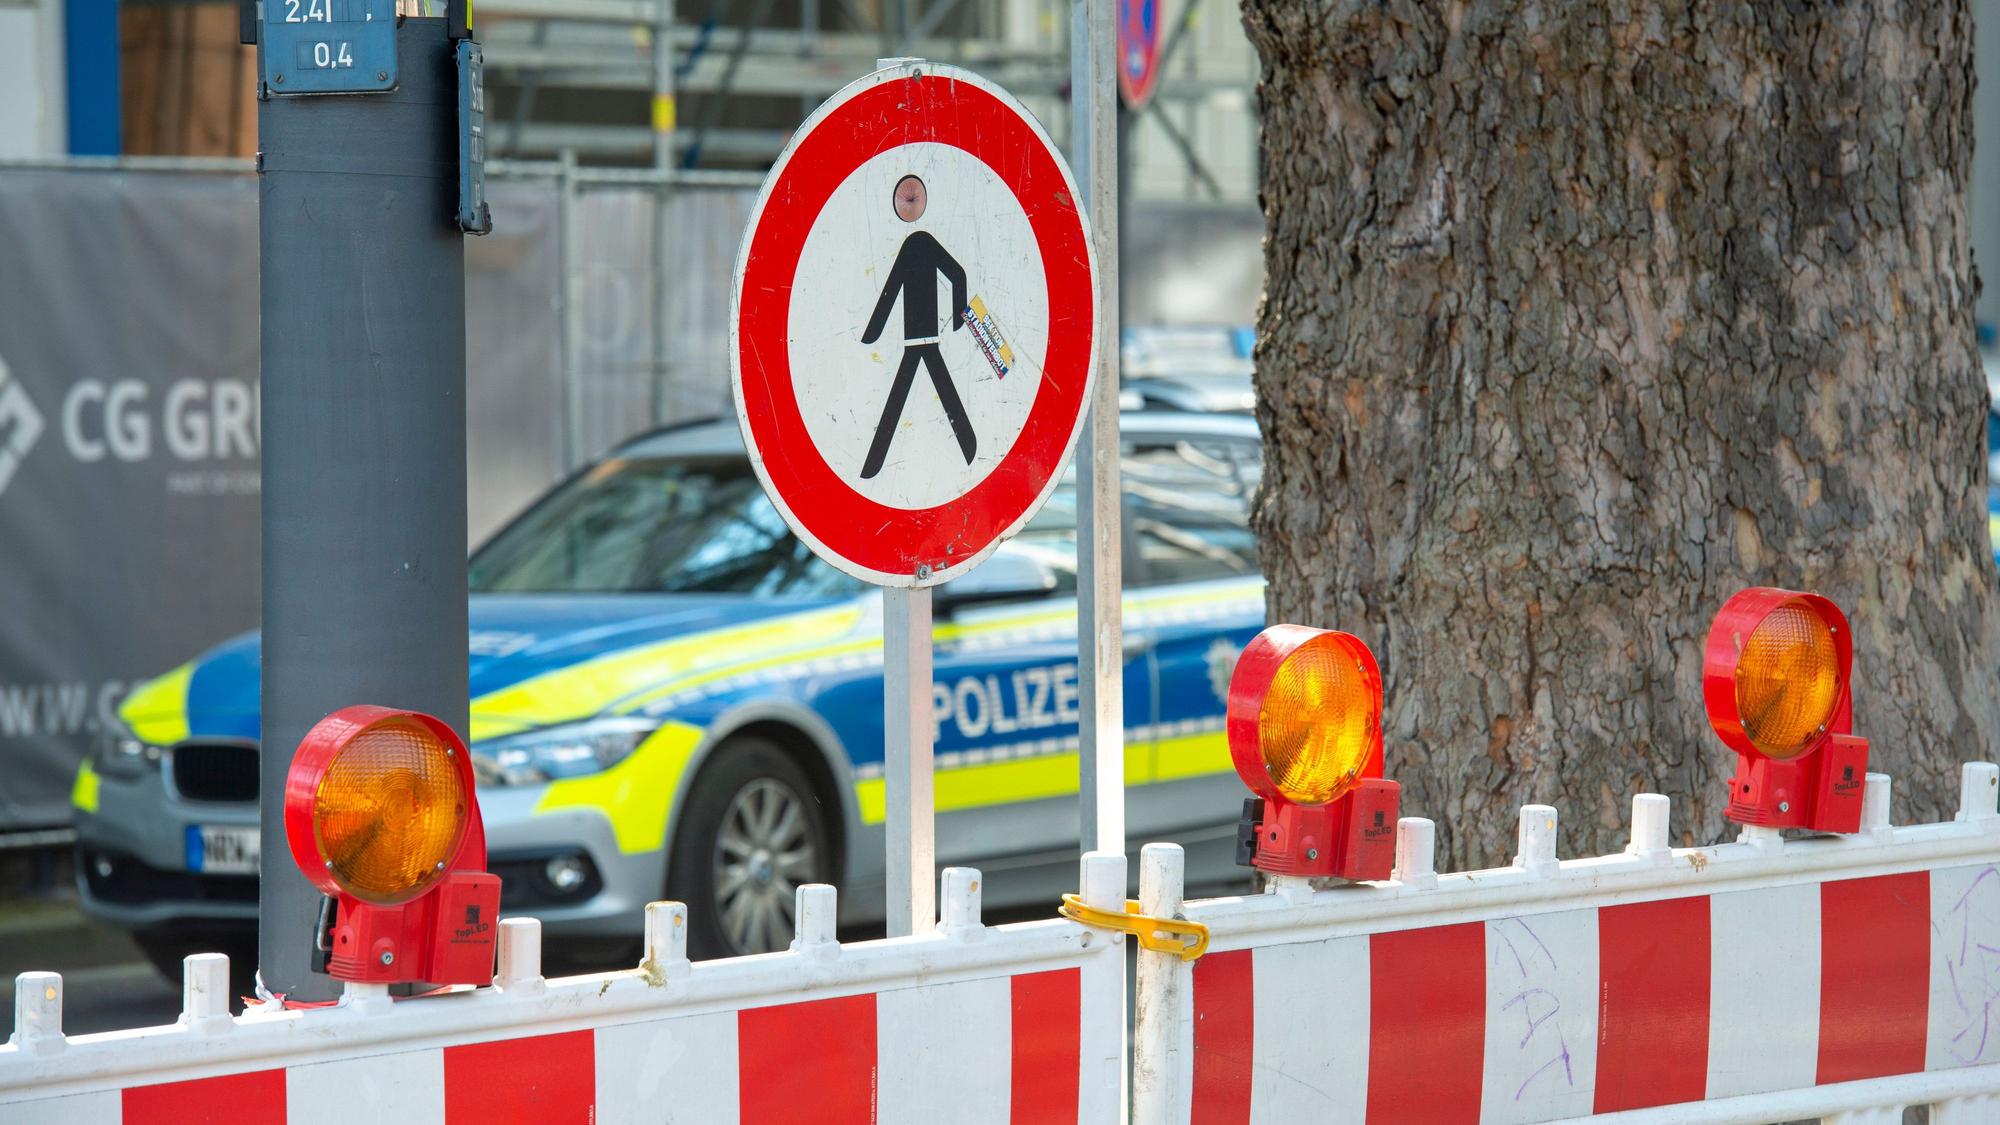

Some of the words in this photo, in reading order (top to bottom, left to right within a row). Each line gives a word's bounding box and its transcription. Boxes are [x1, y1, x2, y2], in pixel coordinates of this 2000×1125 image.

[314, 42, 353, 69] 0,4
[967, 309, 1007, 370] STADIONVERBOT
[983, 314, 1005, 349] SEKTION
[62, 378, 152, 462] CG
[164, 378, 261, 462] GR
